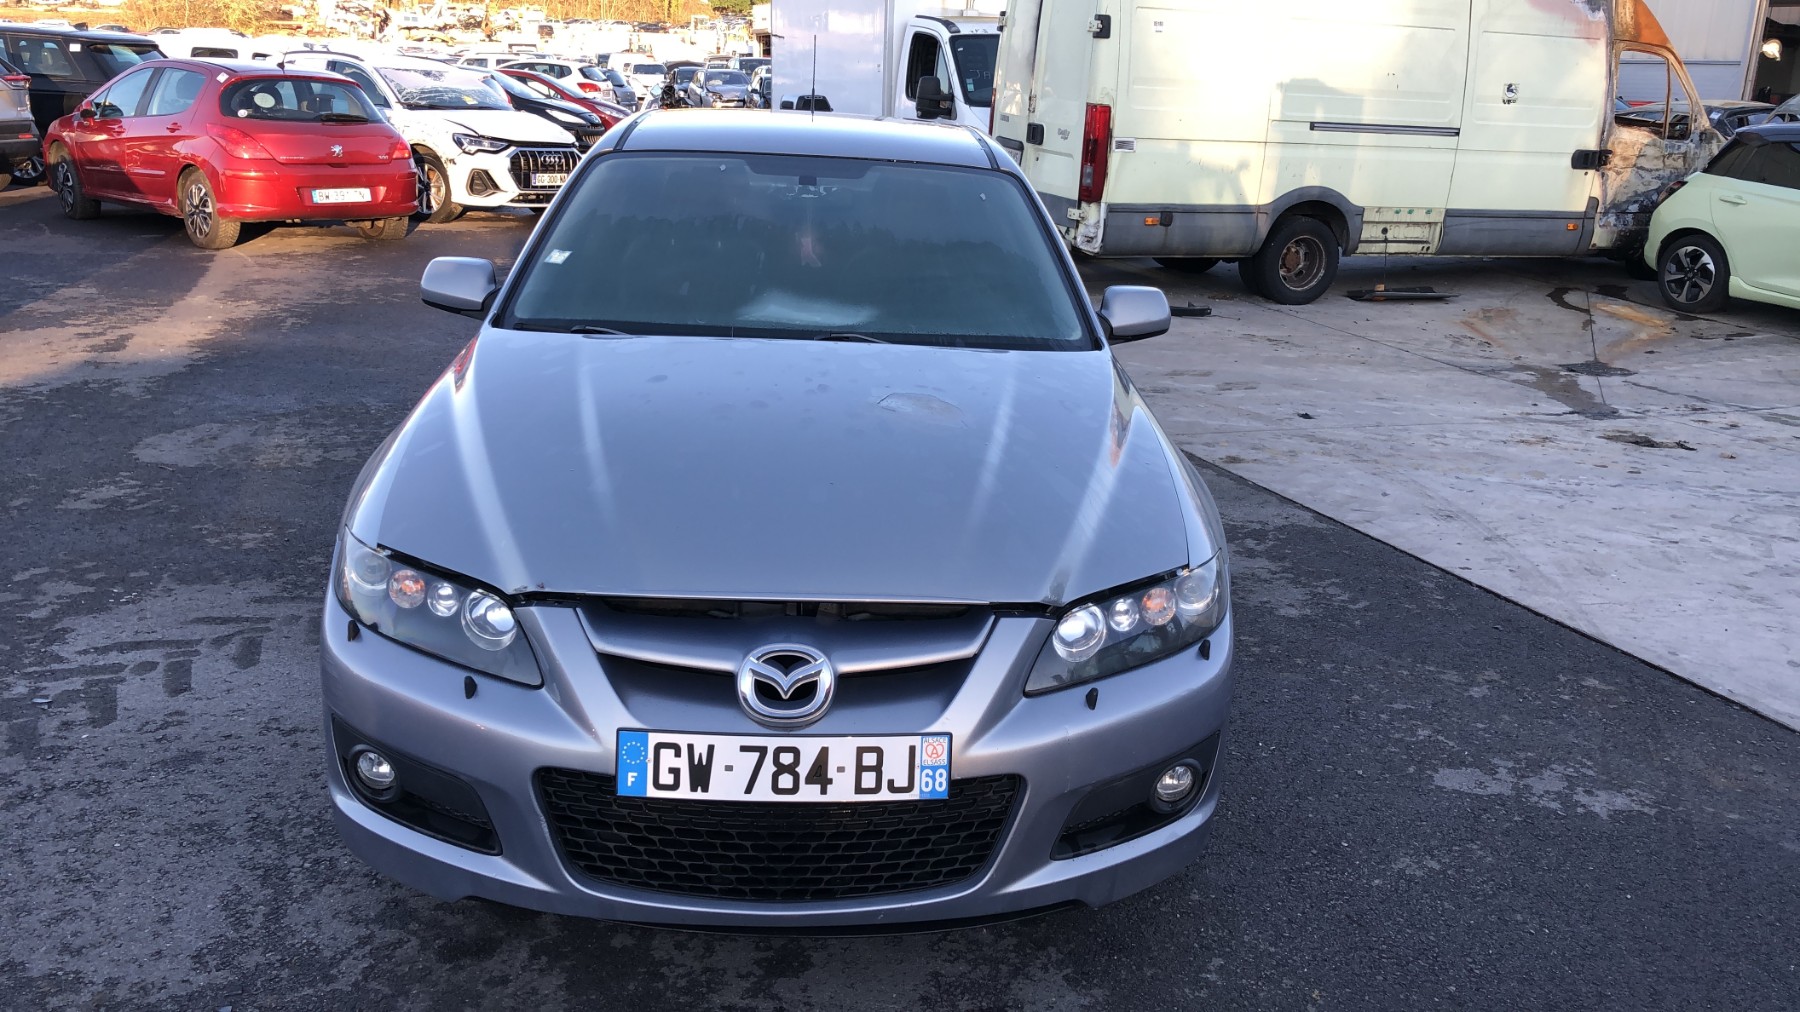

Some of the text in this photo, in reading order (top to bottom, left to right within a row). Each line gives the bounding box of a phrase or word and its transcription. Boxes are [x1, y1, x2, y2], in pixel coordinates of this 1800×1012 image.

[652, 741, 917, 796] GW-784-BJ
[923, 758, 946, 766] ELSASS
[627, 772, 638, 787] F
[920, 768, 947, 793] 68
